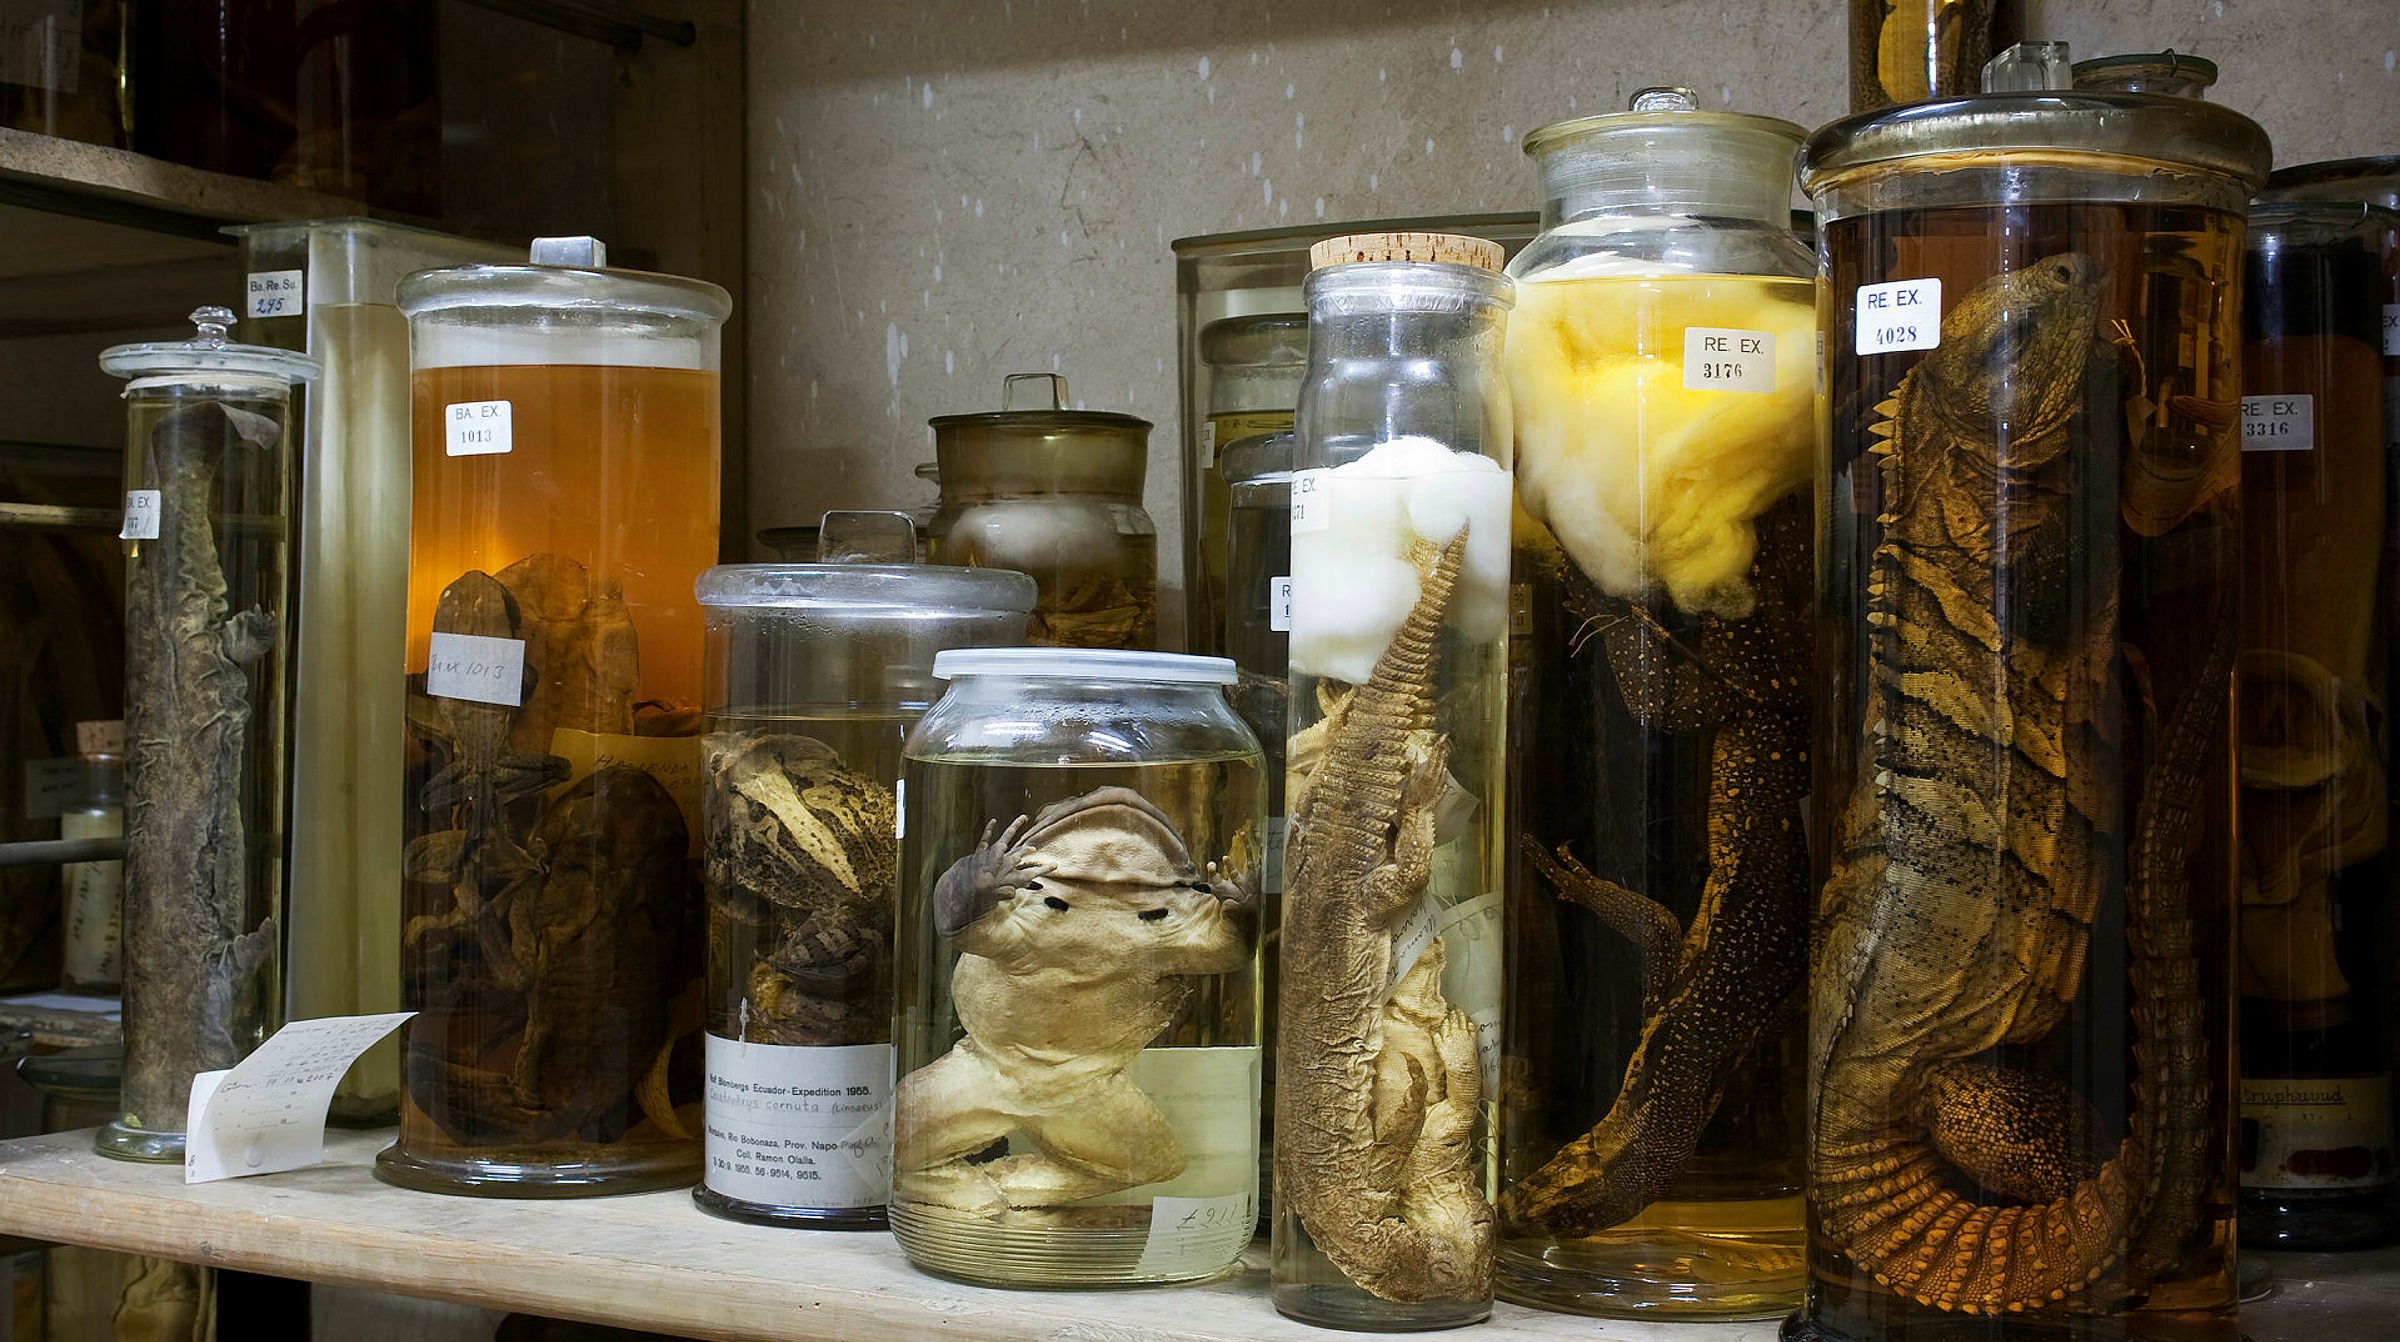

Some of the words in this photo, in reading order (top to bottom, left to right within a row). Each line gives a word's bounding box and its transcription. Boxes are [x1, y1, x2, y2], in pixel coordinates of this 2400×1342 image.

[1867, 291, 1891, 310] RE.
[1896, 288, 1922, 307] EX.
[1875, 325, 1918, 345] 4028
[1703, 335, 1731, 353] RE.
[1740, 338, 1764, 355] EX.
[1703, 362, 1743, 379] 3176
[455, 406, 475, 421] BA.
[480, 404, 502, 419] EX.
[2272, 401, 2299, 416] EX.
[461, 429, 493, 443] 1013
[2246, 421, 2289, 437] 3316
[465, 661, 505, 680] 1013
[845, 1086, 872, 1097] 1955.
[765, 1099, 819, 1113] cornuta
[784, 1139, 807, 1151] Prov.
[811, 1141, 838, 1152] Napo
[755, 1151, 784, 1163] Ramon
